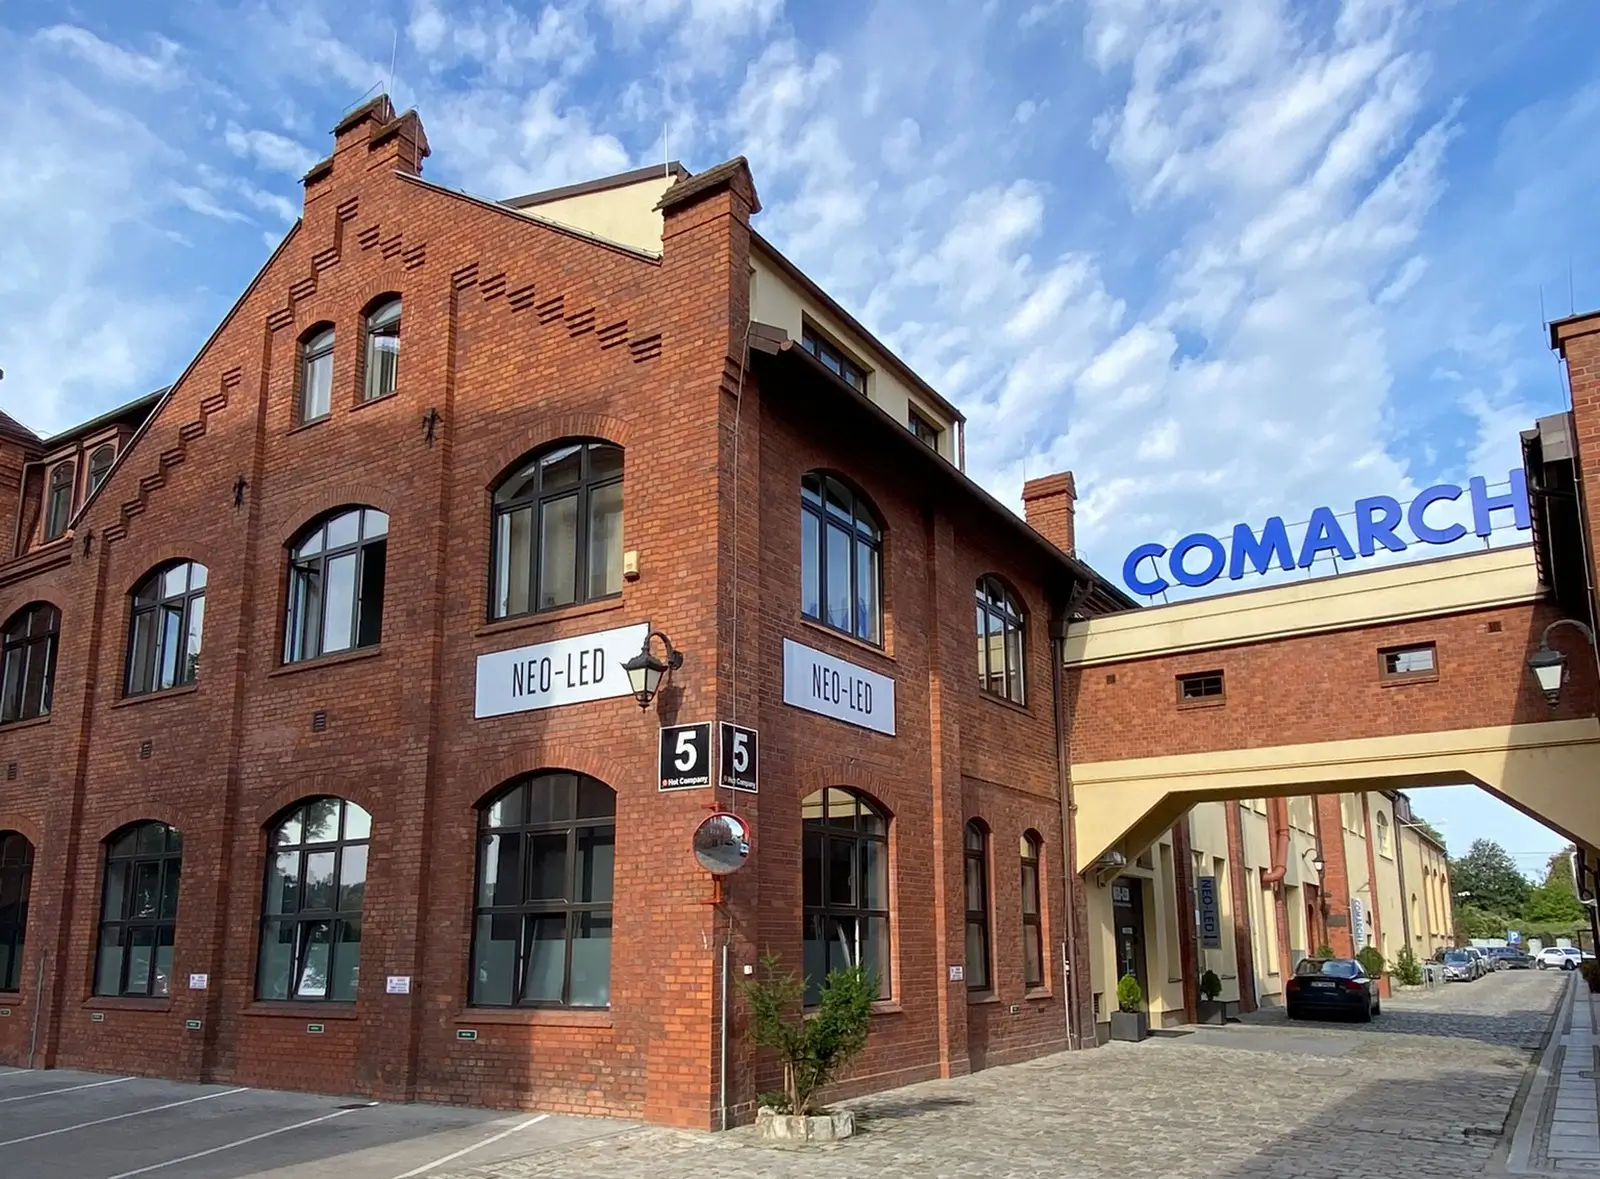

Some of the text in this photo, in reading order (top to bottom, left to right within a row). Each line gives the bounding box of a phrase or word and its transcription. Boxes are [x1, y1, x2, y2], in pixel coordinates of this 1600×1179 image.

[1122, 468, 1532, 596] COMARCH
[513, 648, 605, 698] NEO-LED
[812, 663, 873, 715] NEO-LED
[674, 730, 698, 772] 5
[733, 732, 749, 773] 5
[668, 776, 708, 786] Hot Company
[737, 778, 756, 789] Company
[1201, 880, 1214, 932] NEO-LED
[1510, 931, 1518, 942] P
